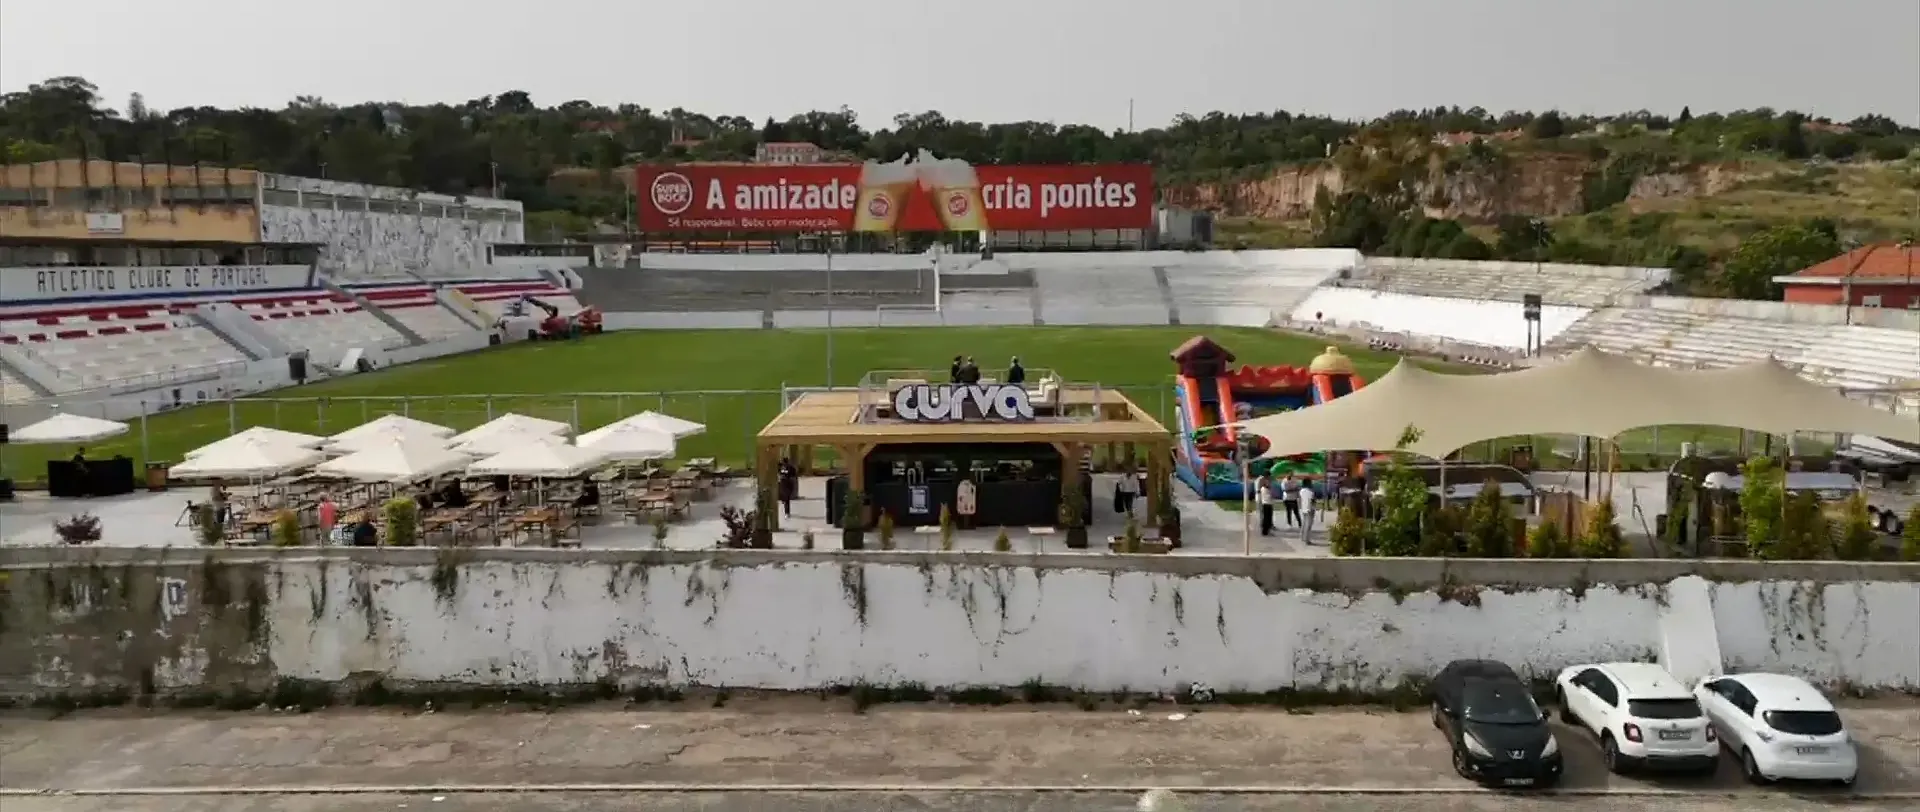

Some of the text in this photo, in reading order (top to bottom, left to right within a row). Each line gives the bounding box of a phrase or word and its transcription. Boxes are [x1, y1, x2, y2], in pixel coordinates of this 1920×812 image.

[656, 183, 688, 193] SUPER
[657, 193, 687, 203] BOCK
[706, 178, 726, 210] A
[735, 177, 856, 210] amizade
[982, 176, 1031, 209] cria
[1041, 176, 1137, 218] pontes
[129, 269, 172, 290] CLUBE
[185, 268, 199, 287] DE
[212, 266, 268, 287] PORTUGAL
[895, 384, 1035, 420] curva
